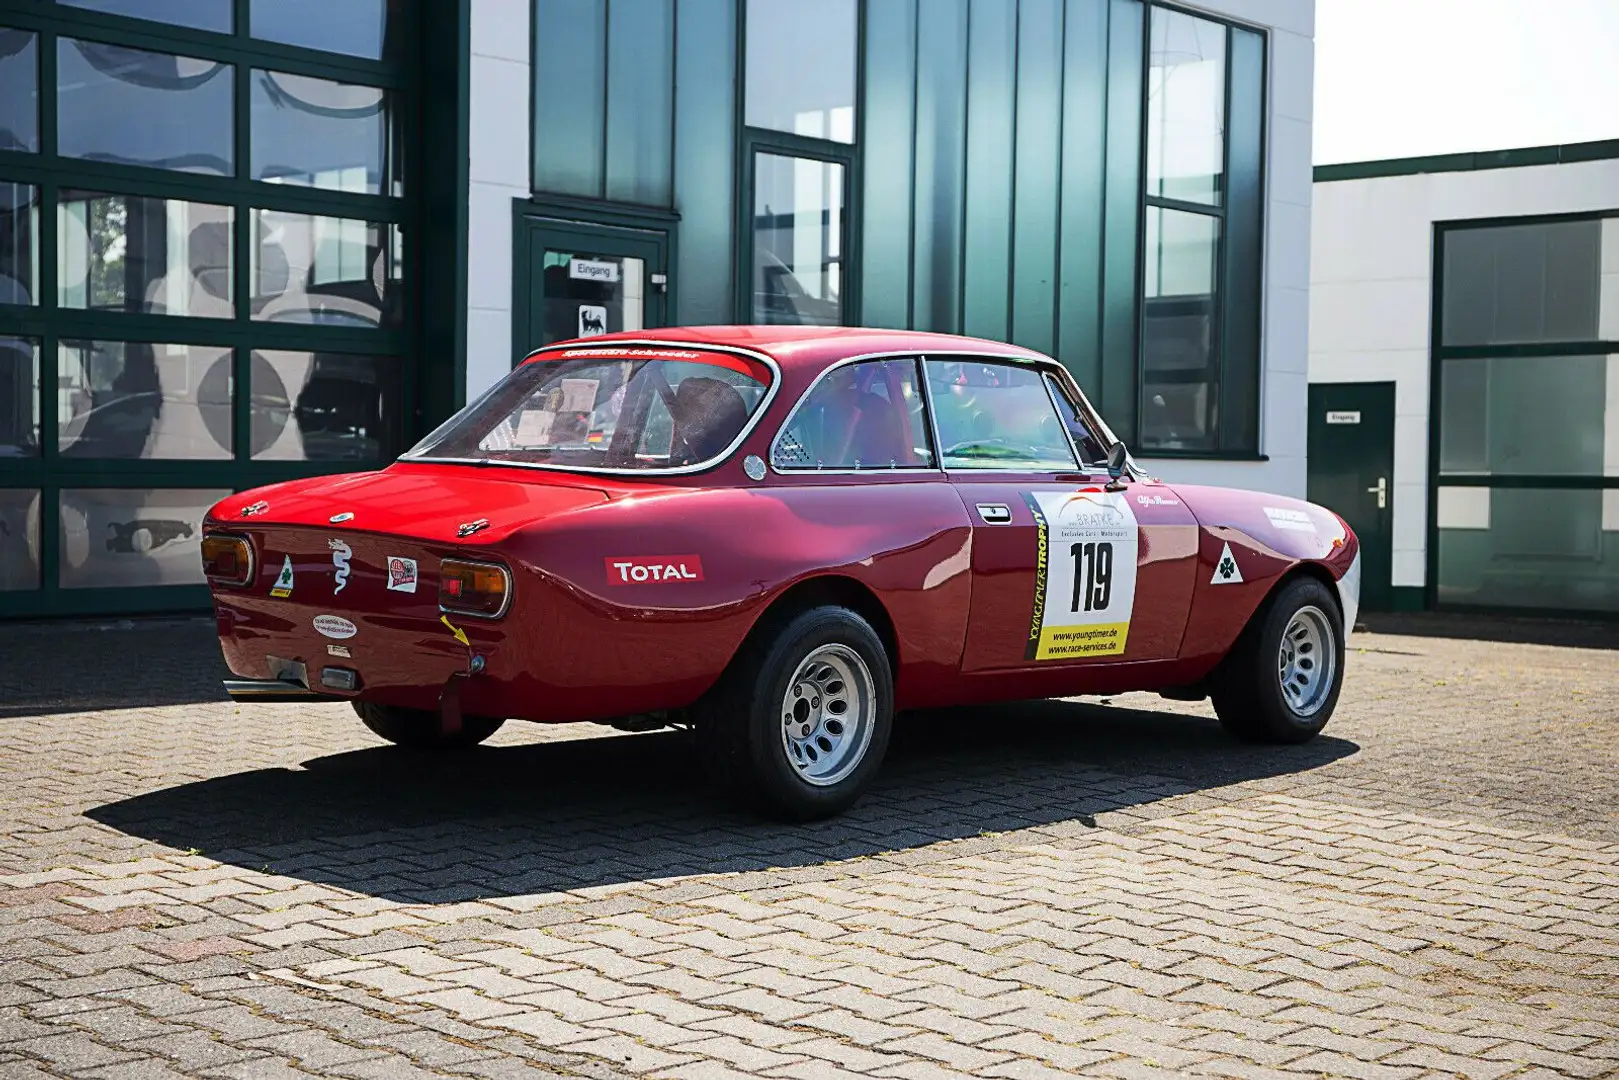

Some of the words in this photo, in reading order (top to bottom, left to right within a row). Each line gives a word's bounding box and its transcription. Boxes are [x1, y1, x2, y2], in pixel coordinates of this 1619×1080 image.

[577, 263, 611, 277] Eingang
[613, 562, 697, 582] TOTAL
[1070, 542, 1113, 612] 119
[1053, 629, 1118, 641] www.youngtimer.de
[1048, 642, 1117, 654] www.race-services.de
